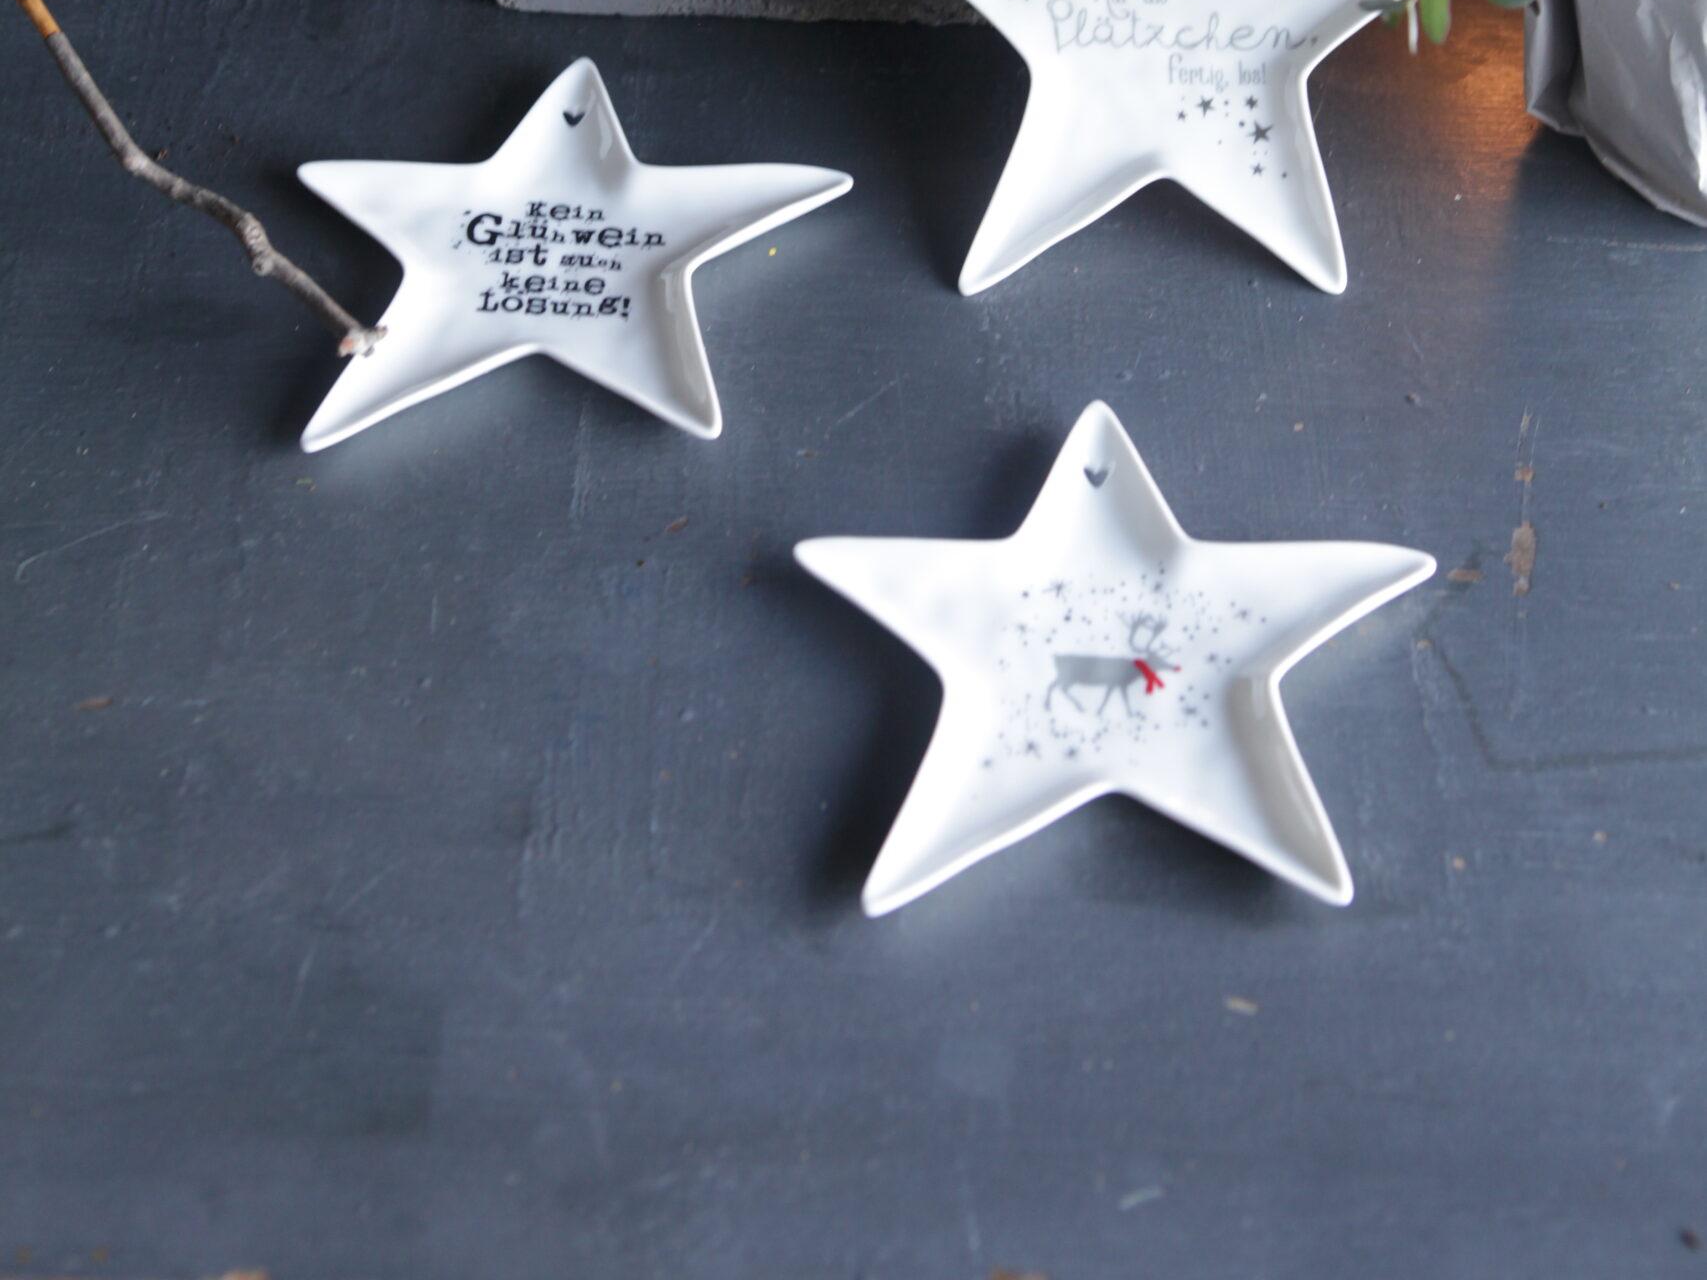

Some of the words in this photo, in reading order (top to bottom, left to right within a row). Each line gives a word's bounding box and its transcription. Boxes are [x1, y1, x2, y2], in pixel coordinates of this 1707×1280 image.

[1237, 60, 1267, 86] los!
[527, 201, 604, 221] Kein
[466, 213, 666, 249] Glühwein
[489, 244, 547, 266] ist
[559, 253, 622, 271] auch
[500, 271, 606, 295] keine
